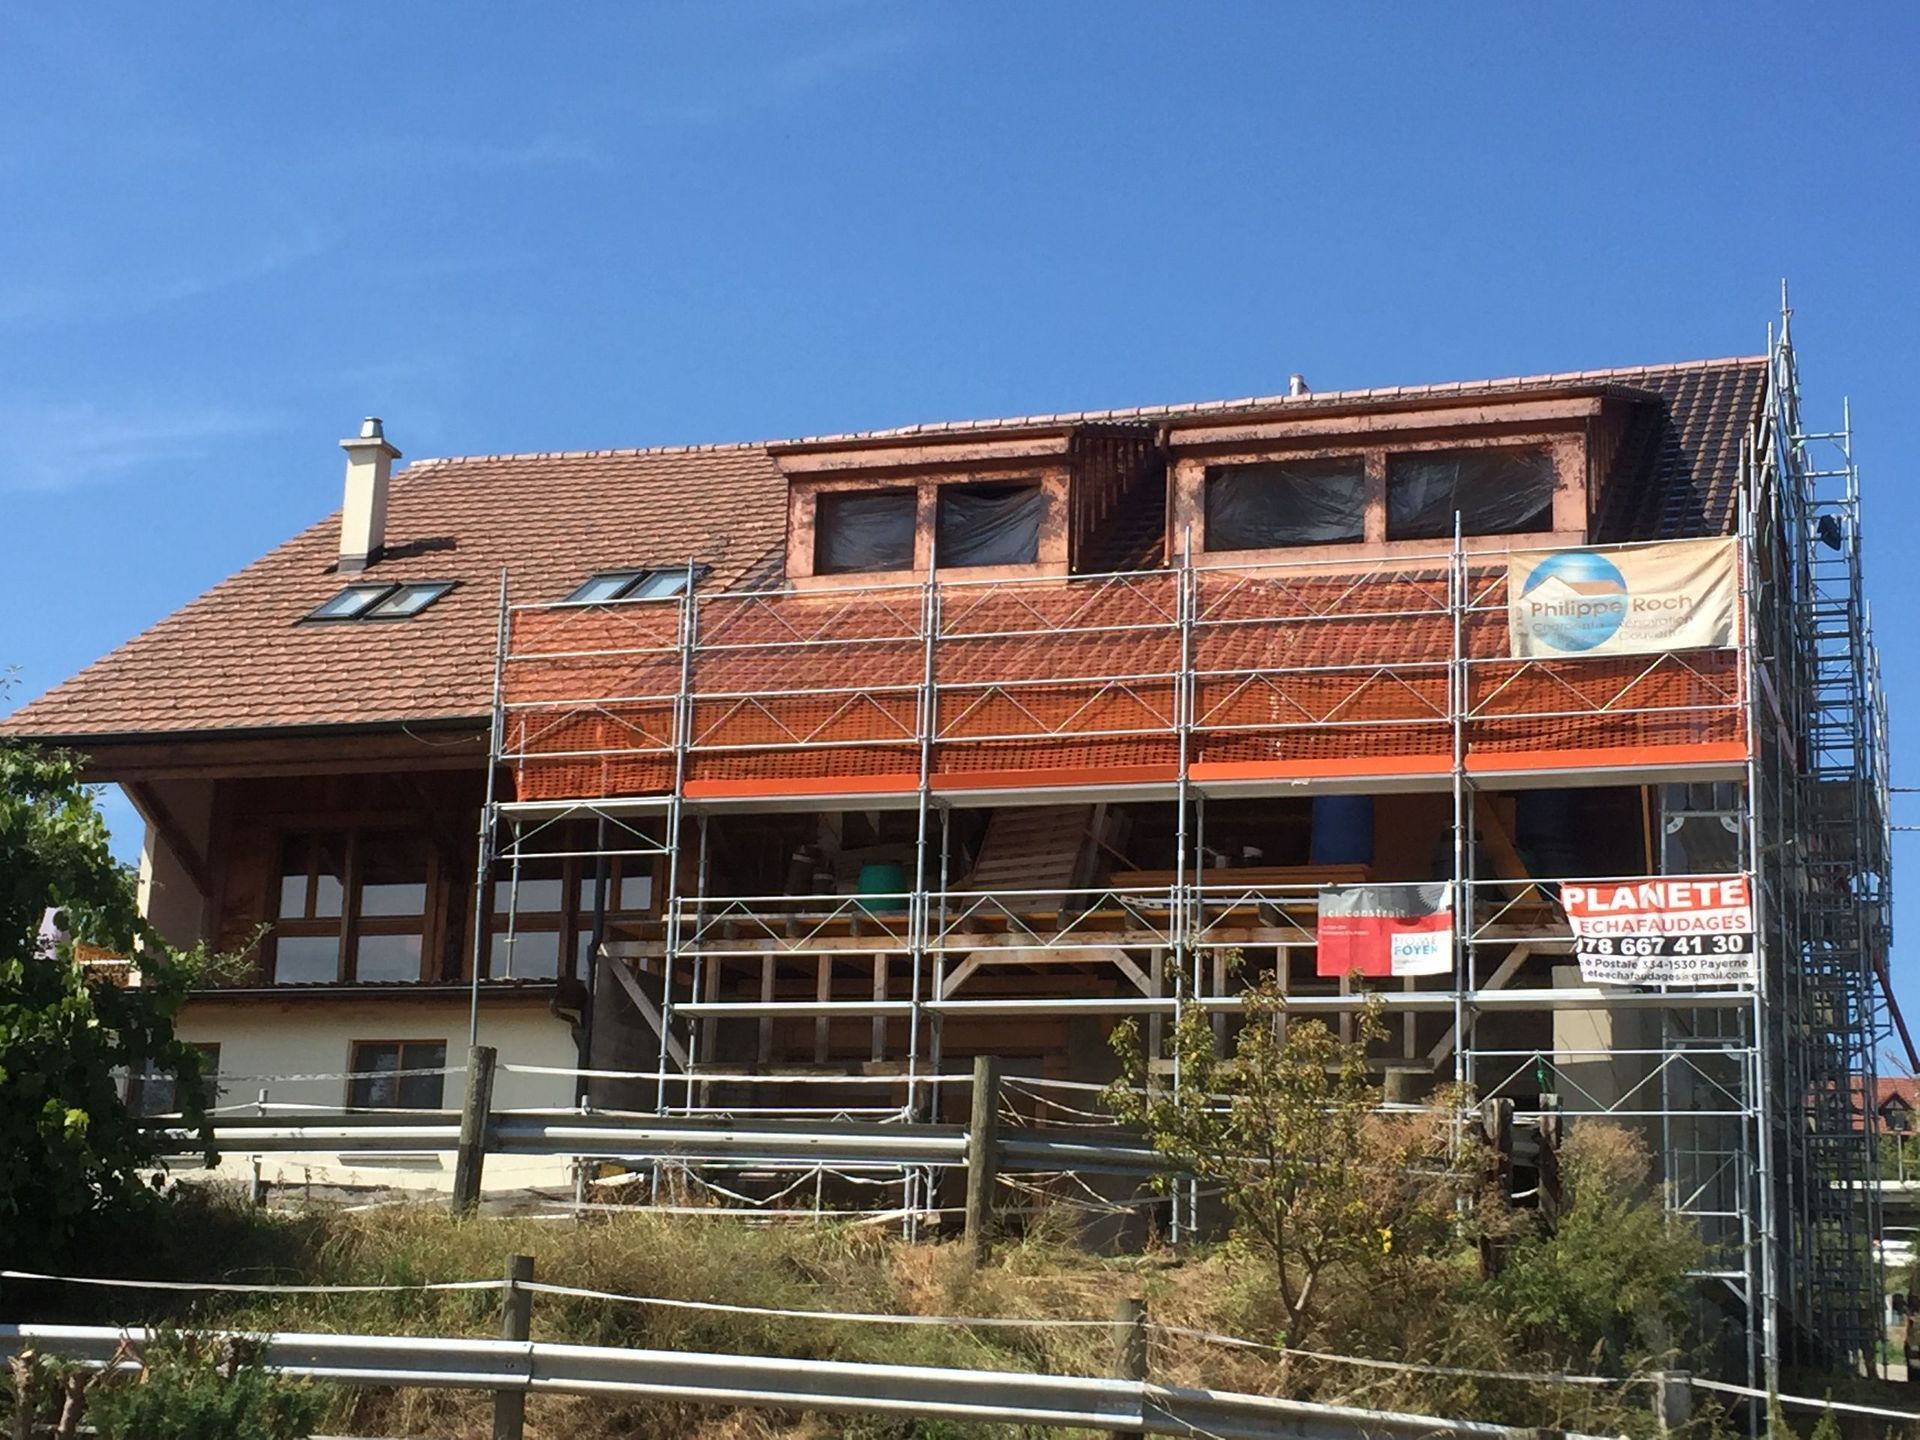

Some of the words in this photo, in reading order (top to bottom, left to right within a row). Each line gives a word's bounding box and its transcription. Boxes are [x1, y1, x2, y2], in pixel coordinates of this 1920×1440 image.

[1531, 599, 1622, 619] Philippe
[1633, 595, 1693, 612] Roch
[1561, 880, 1745, 912] PLANETE
[1580, 915, 1746, 933] ECHAFAUDAGES
[1621, 937, 1665, 956] 667
[1673, 936, 1702, 955] 41
[1712, 934, 1744, 953] 30
[1595, 959, 1638, 969] Postale
[1700, 959, 1748, 970] Payerne
[1585, 970, 1750, 981] eteechafaudages@gmail.com
